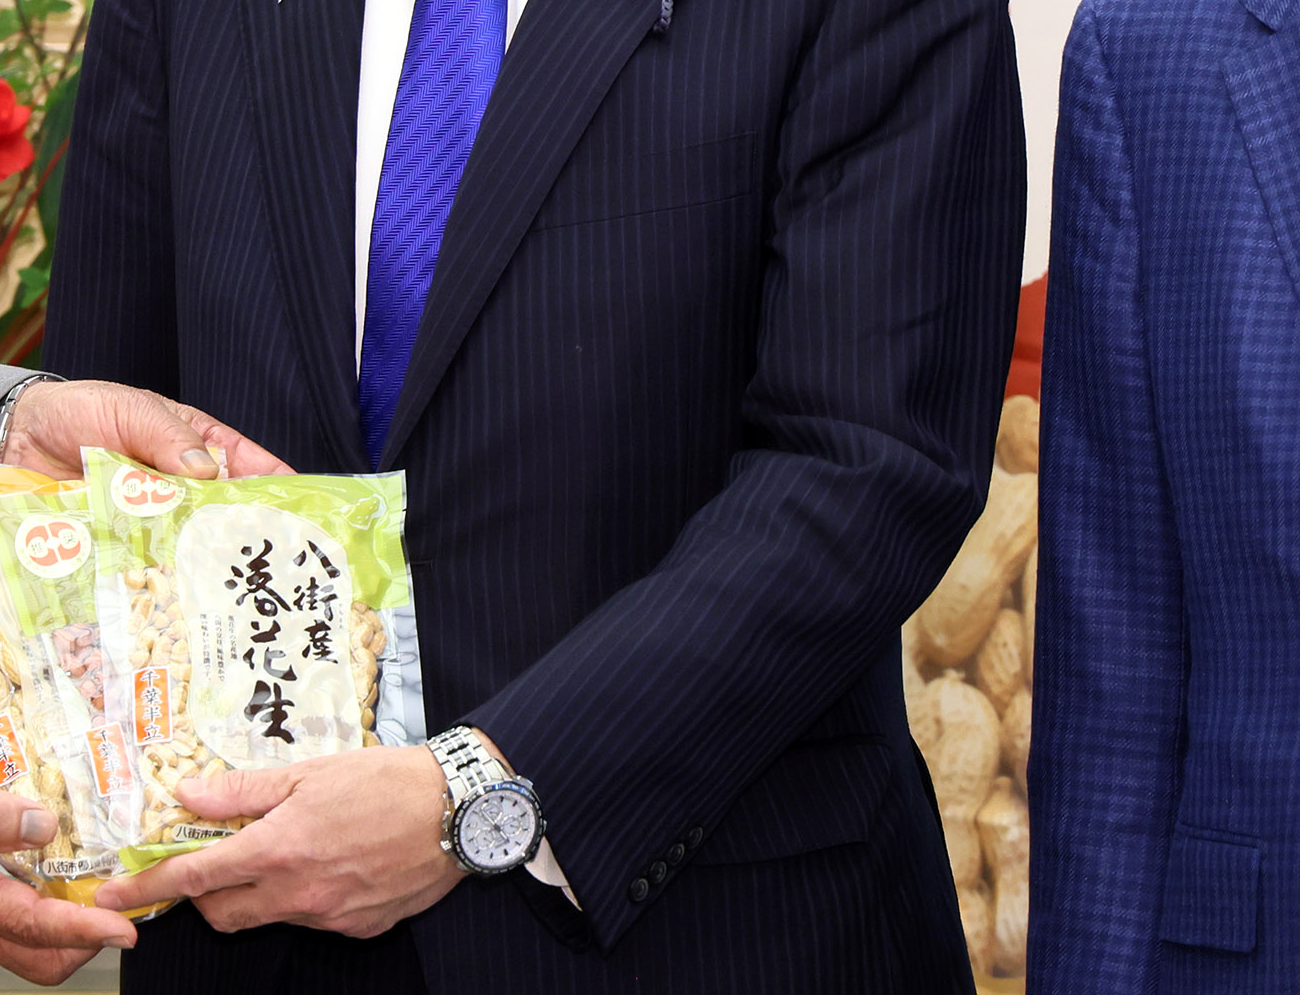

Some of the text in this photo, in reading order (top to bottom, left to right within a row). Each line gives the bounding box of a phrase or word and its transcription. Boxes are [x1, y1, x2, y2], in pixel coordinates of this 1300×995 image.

[224, 538, 297, 745] 落花生
[292, 539, 341, 664] 八街産
[139, 669, 166, 742] 千葉半立
[93, 729, 129, 794] 千葉半立
